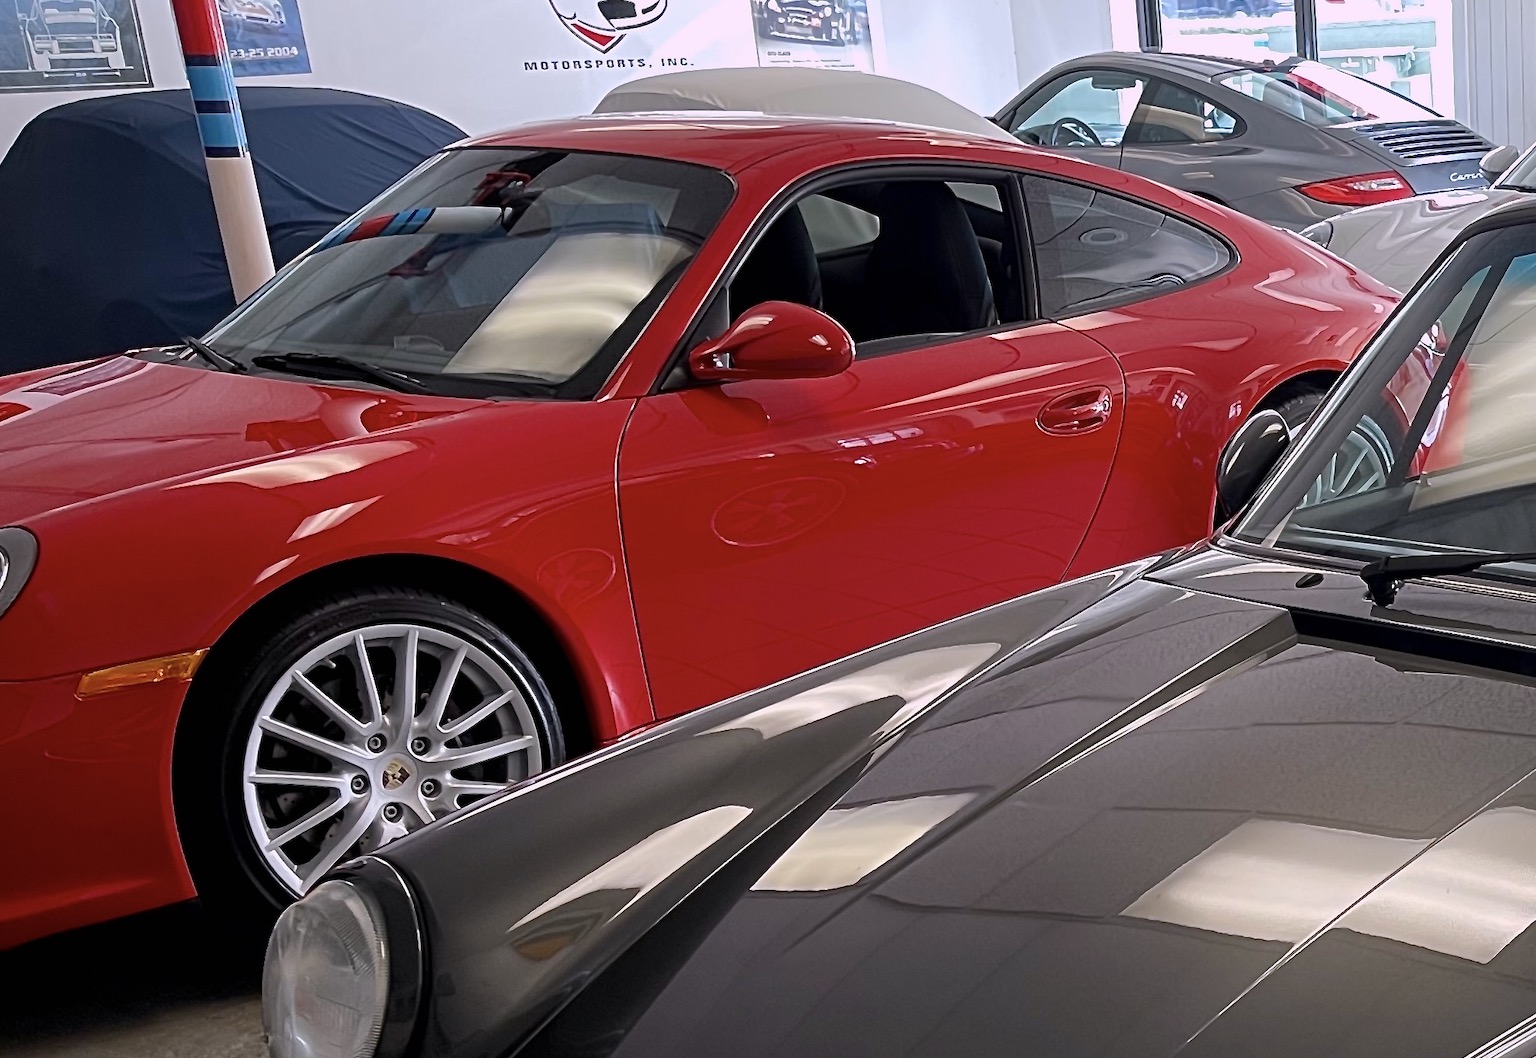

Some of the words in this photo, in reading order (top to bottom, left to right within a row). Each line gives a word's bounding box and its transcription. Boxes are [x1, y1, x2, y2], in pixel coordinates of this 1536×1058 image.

[266, 46, 299, 58] 2004
[524, 58, 653, 71] MOTORSPORTS,
[660, 57, 695, 67] INC.
